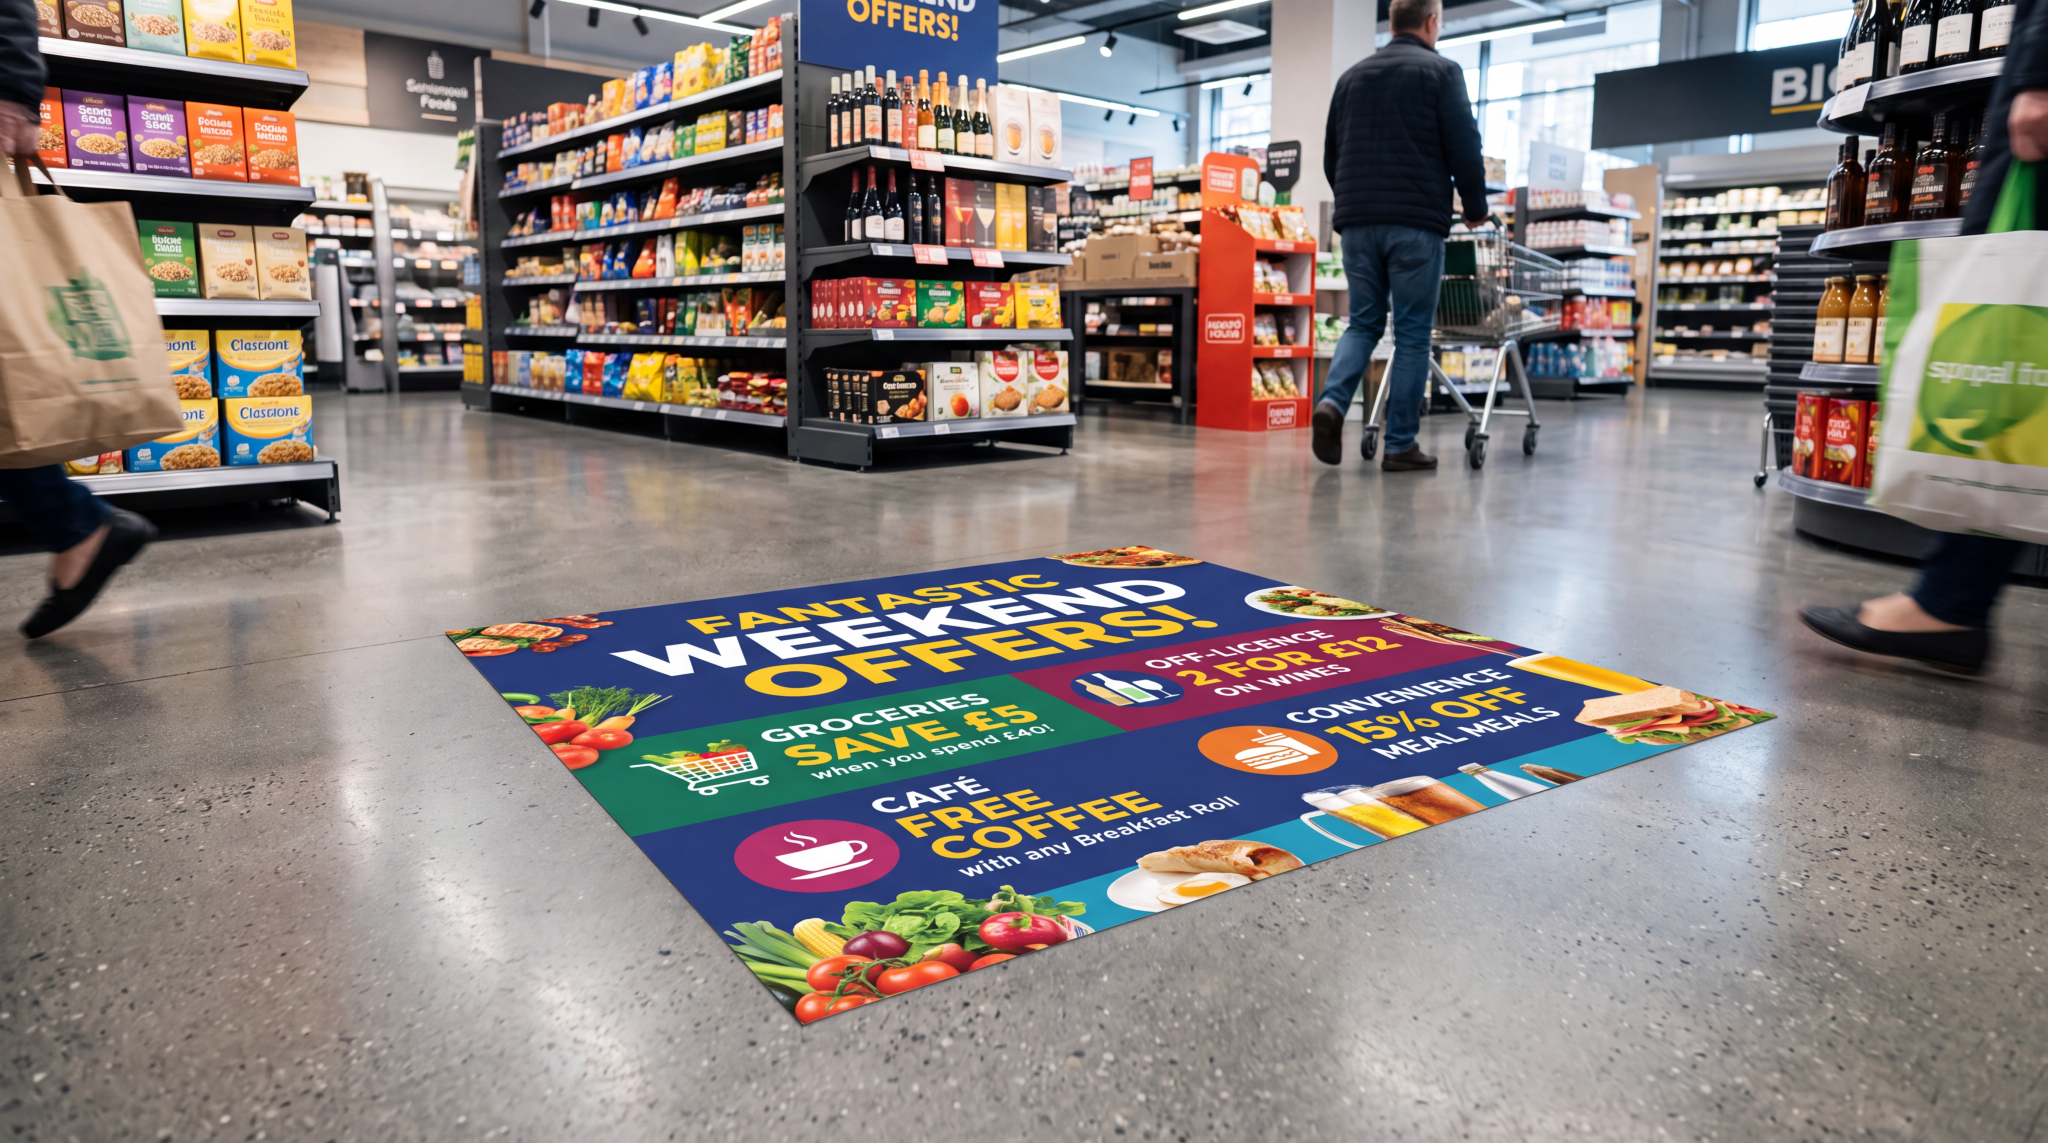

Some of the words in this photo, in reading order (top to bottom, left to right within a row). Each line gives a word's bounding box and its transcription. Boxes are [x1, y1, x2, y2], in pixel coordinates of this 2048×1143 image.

[847, 0, 958, 41] OFFERS!
[1771, 63, 1838, 107] BI
[609, 579, 1186, 677] WEEKEND
[686, 574, 1059, 634] FANTASTIC
[744, 605, 1218, 697] OFFERS!
[1145, 629, 1334, 669] OFF-LICENCE
[1176, 669, 1222, 686] 2
[1213, 650, 1326, 678] FOR
[1319, 636, 1404, 659] £12
[1214, 682, 1261, 697] ON
[1257, 664, 1351, 688] WINES
[1286, 668, 1513, 724] CONVENIENCE
[761, 693, 990, 743] GROCERIES
[784, 719, 961, 766] SAVE
[963, 704, 1038, 732] £5
[1324, 710, 1440, 745] 15%
[1430, 686, 1527, 718] OFF
[1371, 731, 1469, 760] MEAL
[1457, 706, 1560, 737] MEALS
[811, 760, 879, 780] when
[881, 751, 927, 767] you
[931, 734, 1001, 755] spend
[1002, 723, 1055, 742] £40!
[871, 776, 991, 814] CAFÉ
[895, 788, 1054, 839] FREE
[931, 790, 1163, 859] COFFEE
[958, 854, 1021, 878] with
[1024, 842, 1073, 862] any
[1073, 808, 1192, 847] Breakfast
[1187, 795, 1240, 816] Roll
